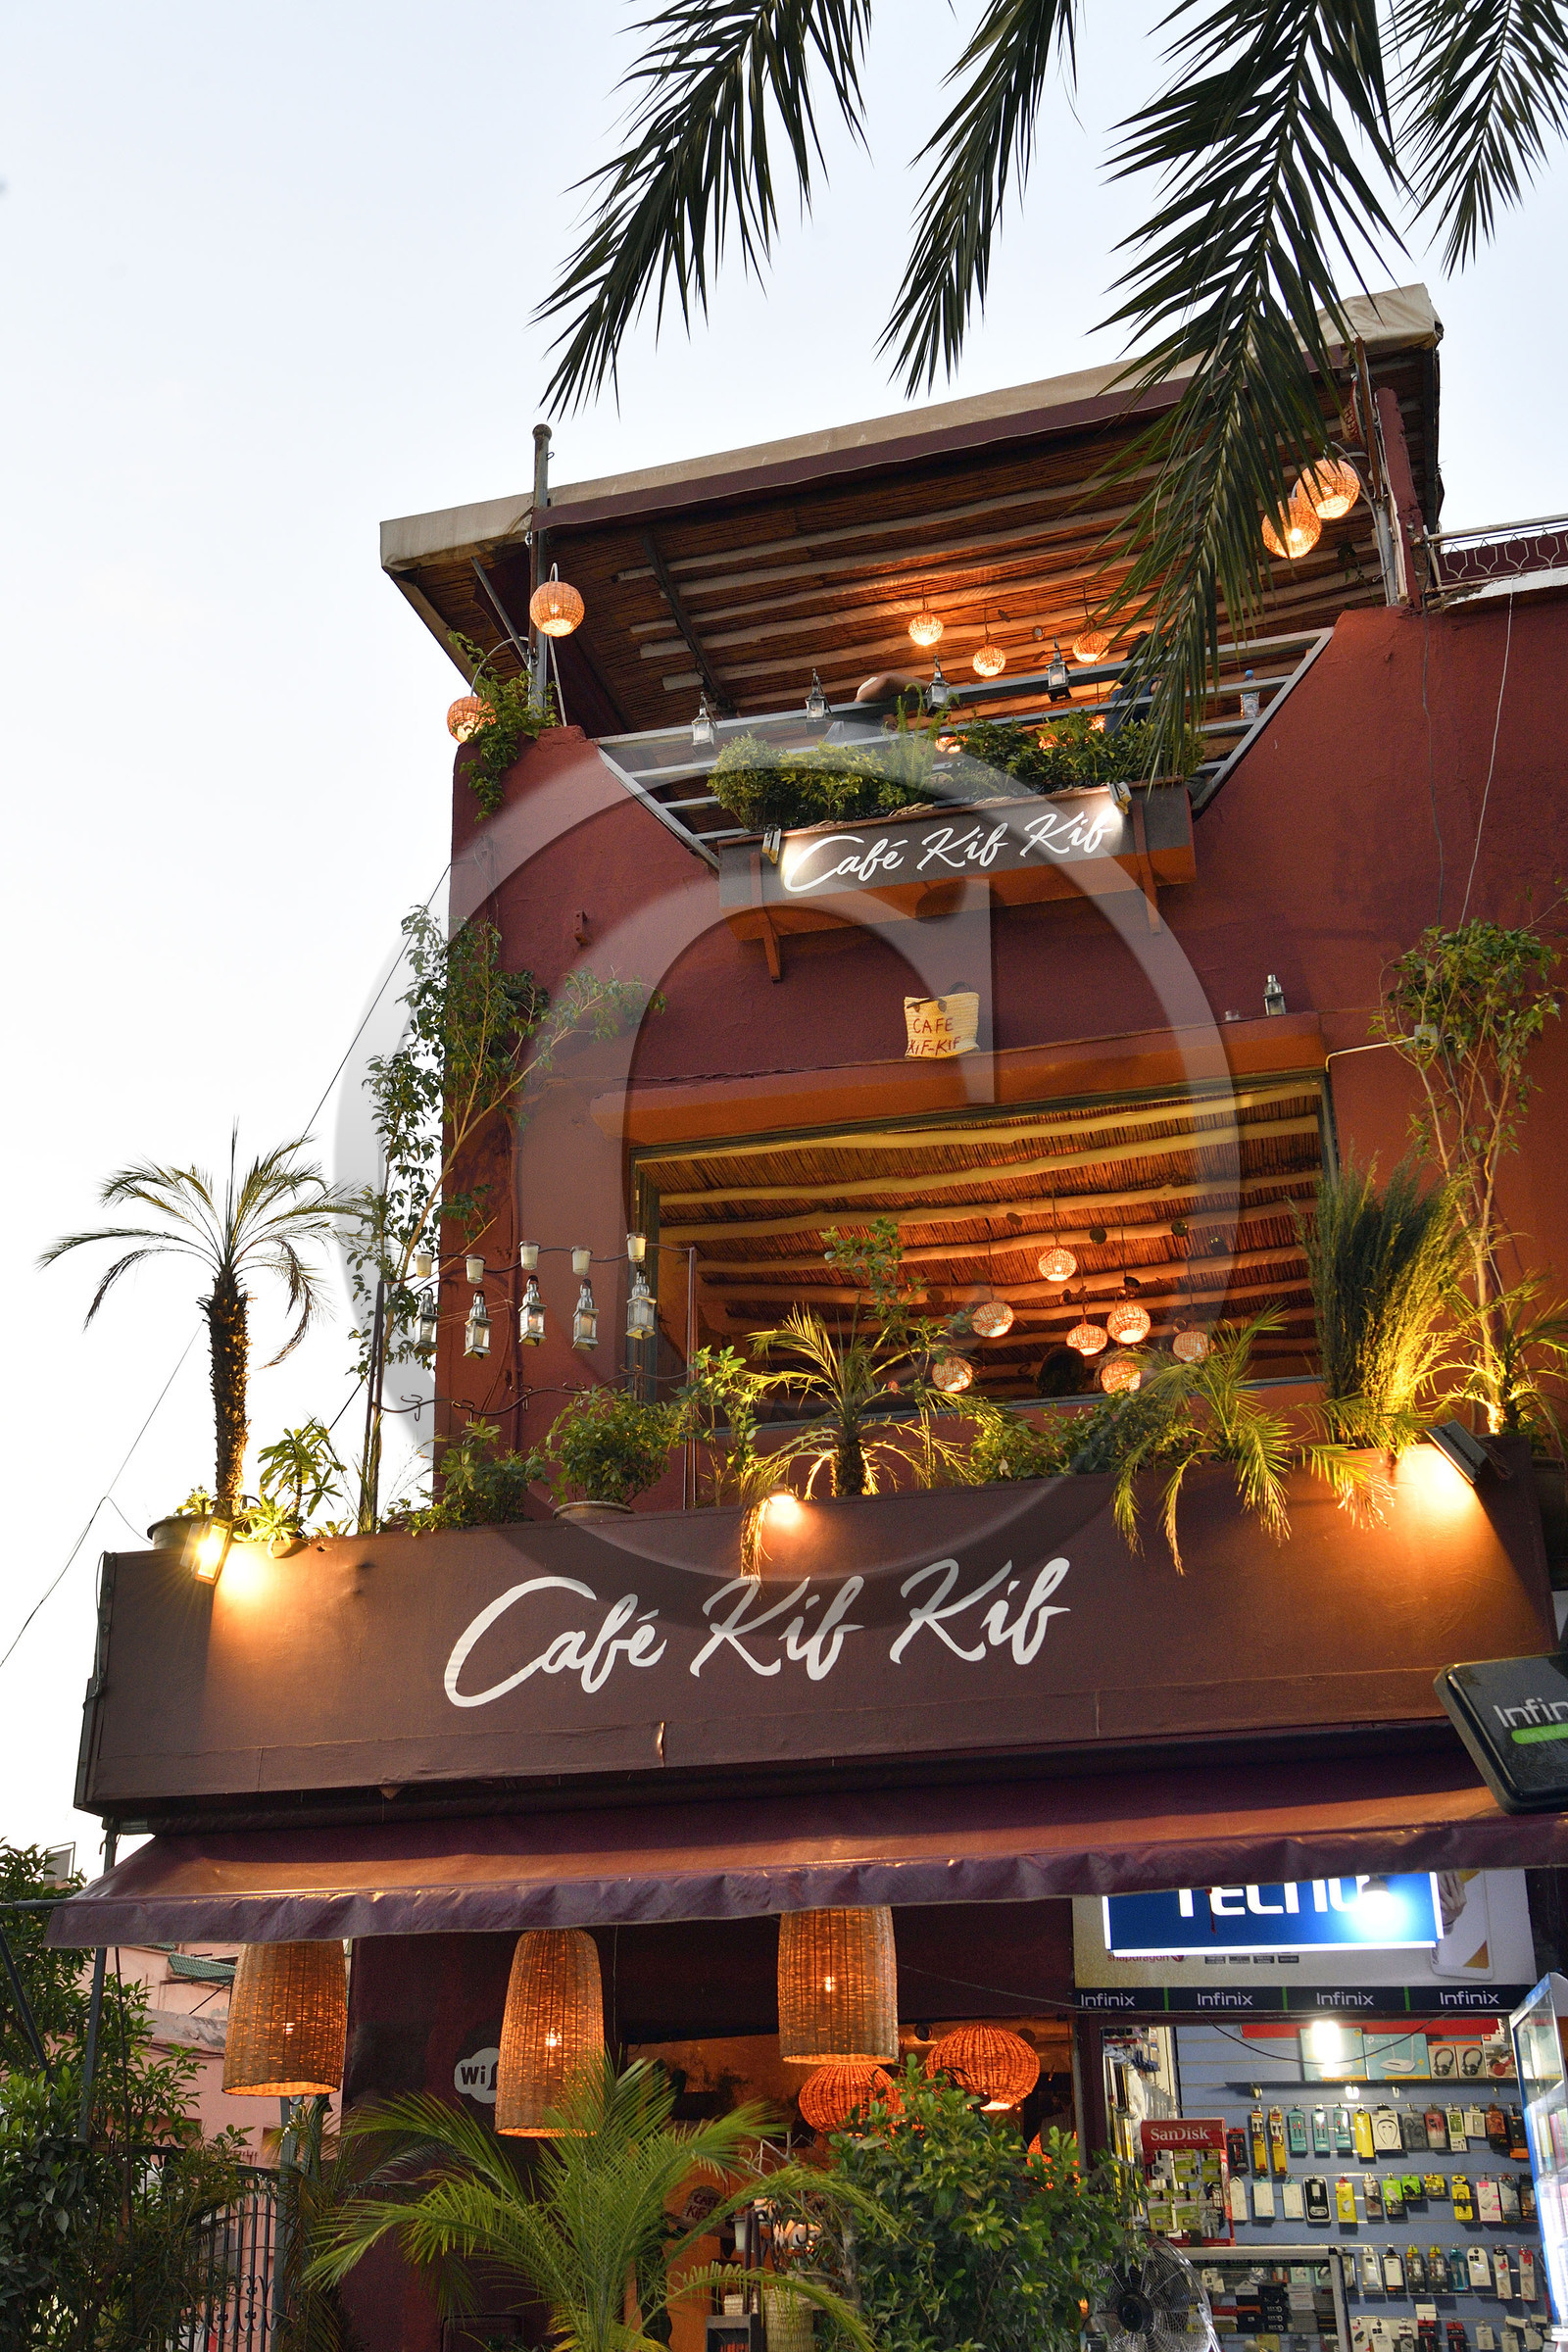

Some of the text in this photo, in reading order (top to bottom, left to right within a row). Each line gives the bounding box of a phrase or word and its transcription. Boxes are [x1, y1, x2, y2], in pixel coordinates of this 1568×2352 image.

[784, 808, 1113, 893] Café Kif Kif
[912, 1017, 955, 1034] CAFE
[444, 1557, 1072, 1707] Café Kif Kif
[1080, 1990, 1500, 2007] Infinix Infinix Infinix Infinix
[1150, 2127, 1210, 2141] SanDisk
